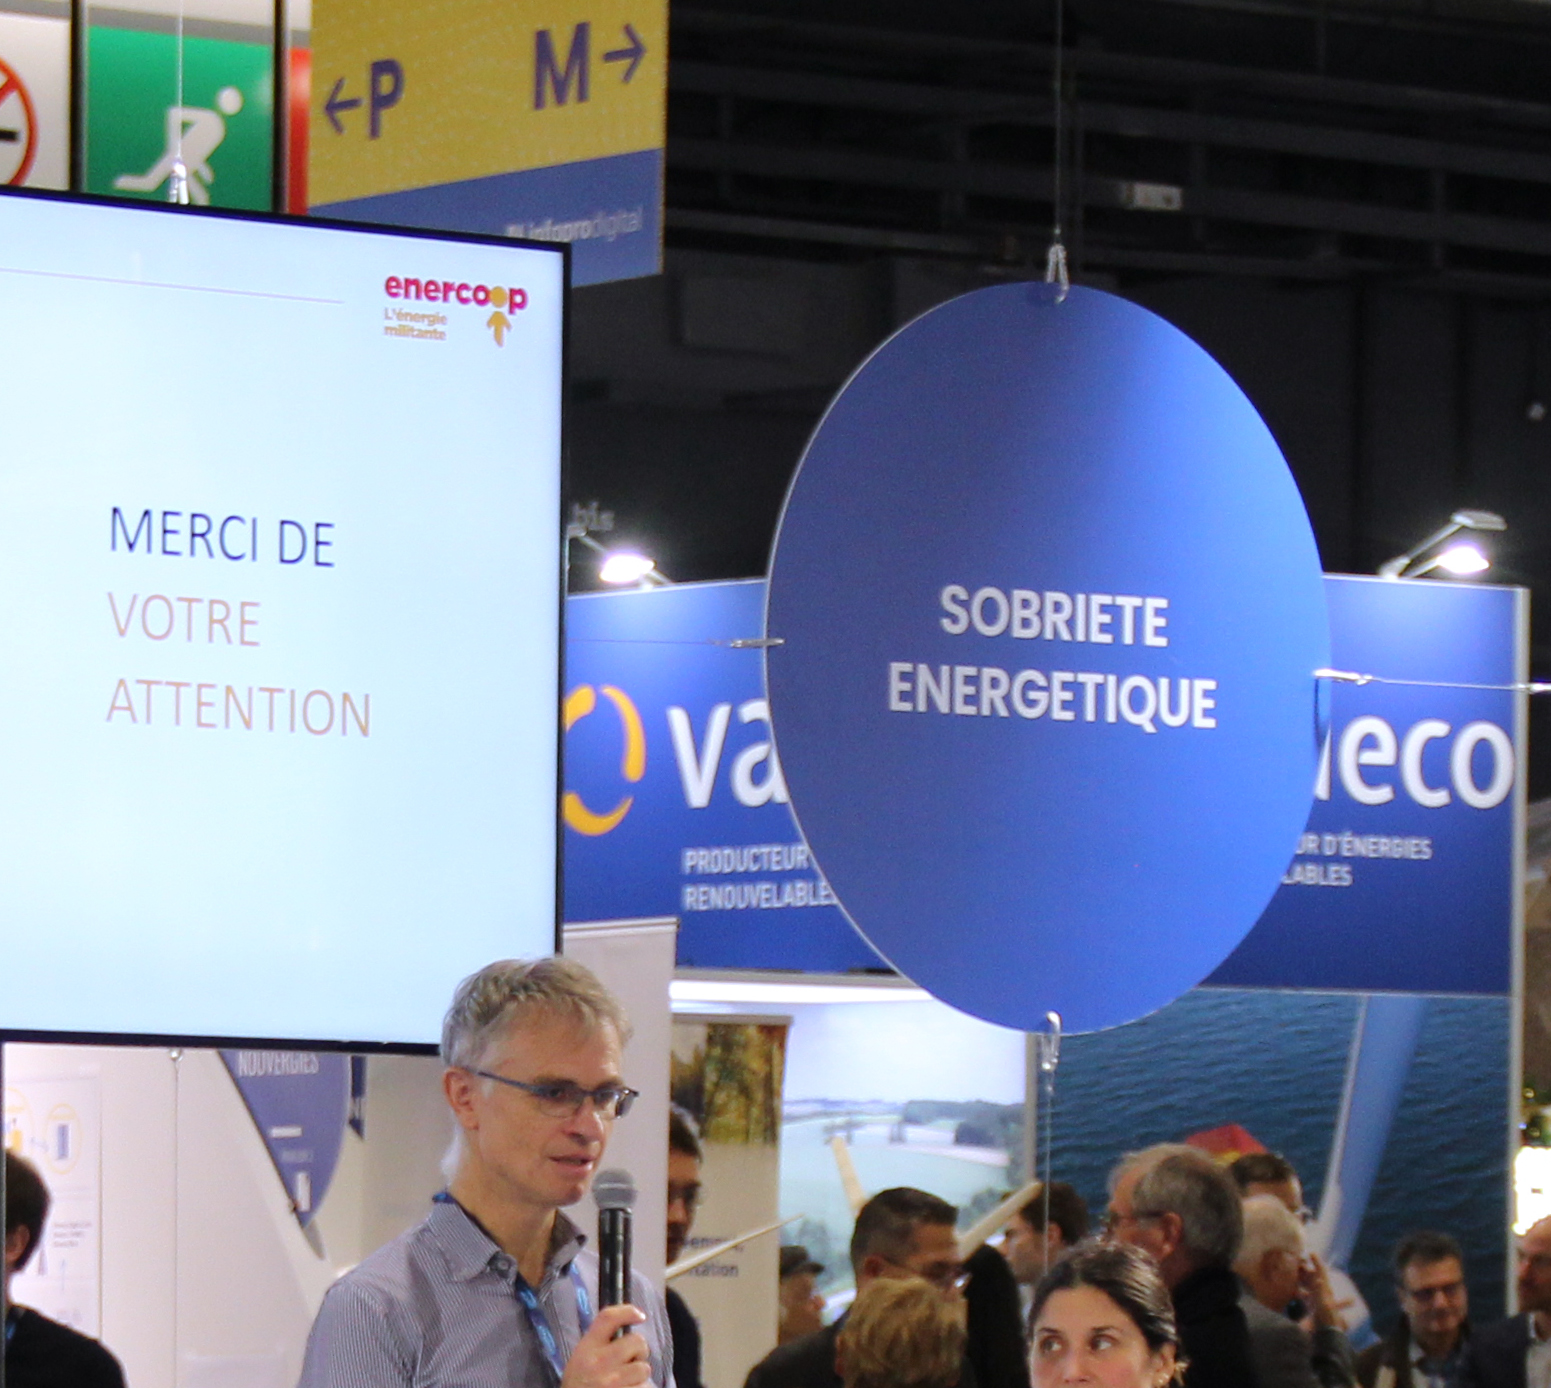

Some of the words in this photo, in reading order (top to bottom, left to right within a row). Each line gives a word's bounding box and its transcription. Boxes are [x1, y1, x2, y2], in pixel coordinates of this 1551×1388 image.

[533, 22, 591, 110] M
[369, 58, 404, 138] P
[385, 275, 528, 315] enercoop
[111, 506, 257, 562] MERCI
[279, 519, 335, 568] DE
[107, 592, 261, 647] VOTRE
[939, 583, 1170, 648] SOBRIETE
[105, 678, 370, 738] ATTENTION
[888, 662, 1218, 734] ENERGETIQUE
[669, 698, 791, 810] va
[683, 842, 810, 874] PRODUCTEUR
[1323, 831, 1434, 860] D'ÉNERGIES
[683, 880, 839, 911] RENOUVELABLE
